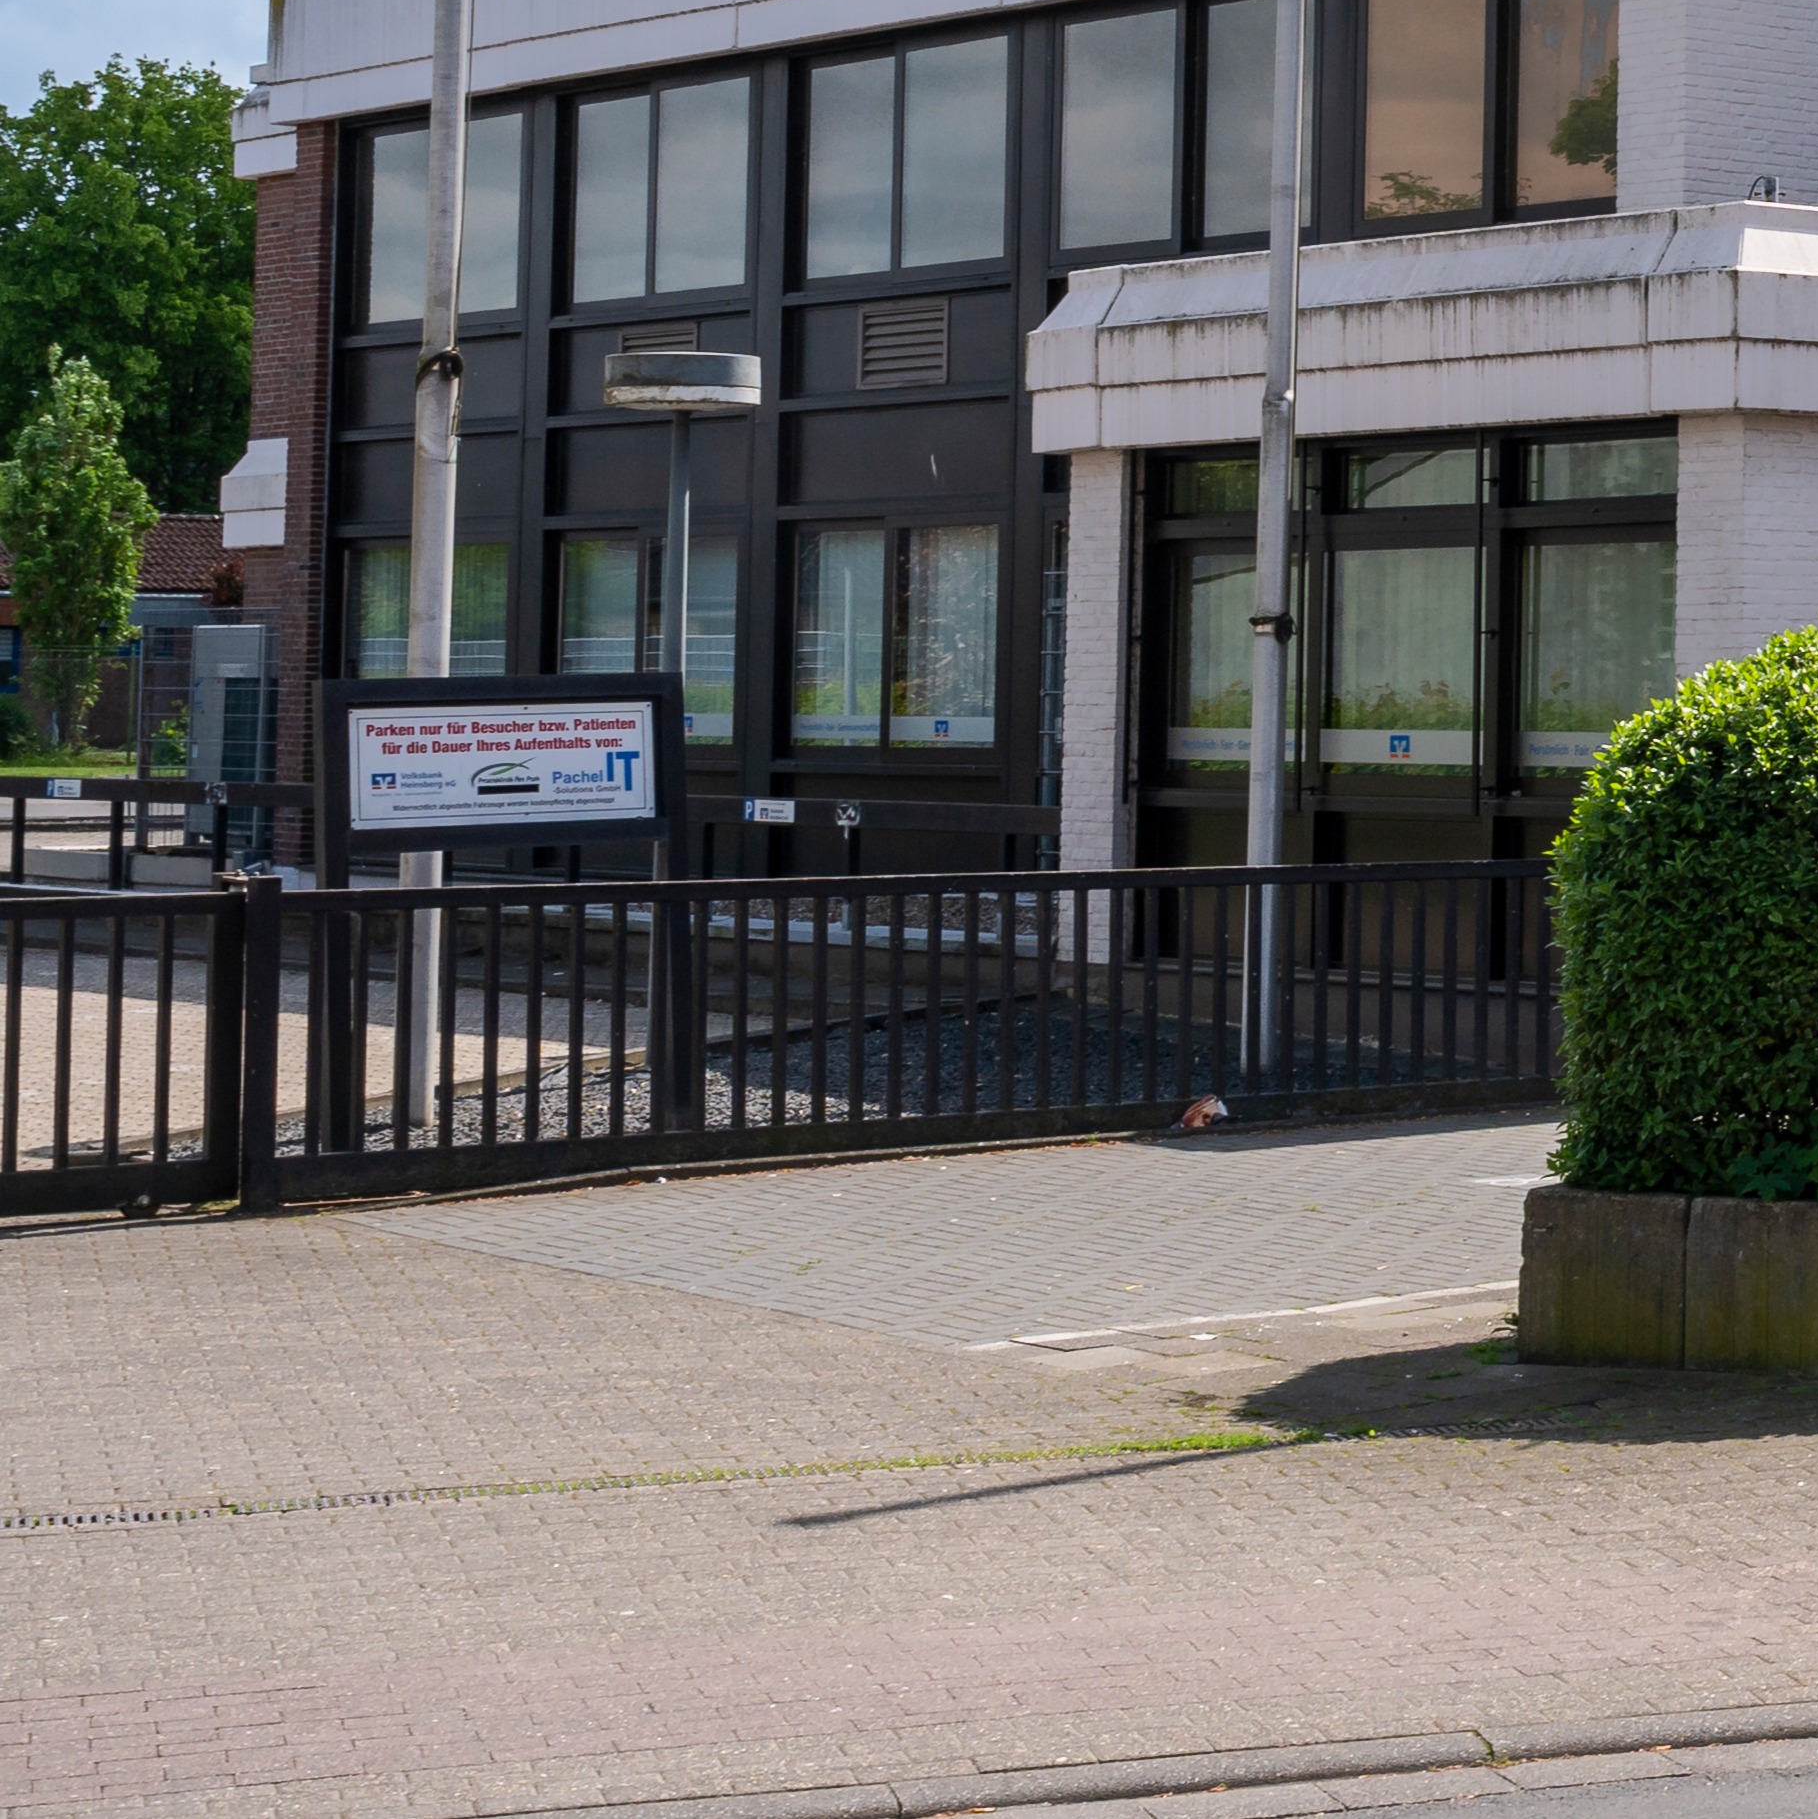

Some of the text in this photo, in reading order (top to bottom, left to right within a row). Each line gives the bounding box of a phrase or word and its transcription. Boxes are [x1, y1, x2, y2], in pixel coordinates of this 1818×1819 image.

[366, 718, 636, 737] Parken nur für Besucher bzw. Patienten
[382, 736, 623, 755] für die Dauer Ihres Aufenthalts von:
[400, 771, 442, 780] Volksbank
[552, 751, 640, 791] Pachel IT
[445, 780, 456, 788] eG
[553, 784, 622, 794] -Solutions GmbH
